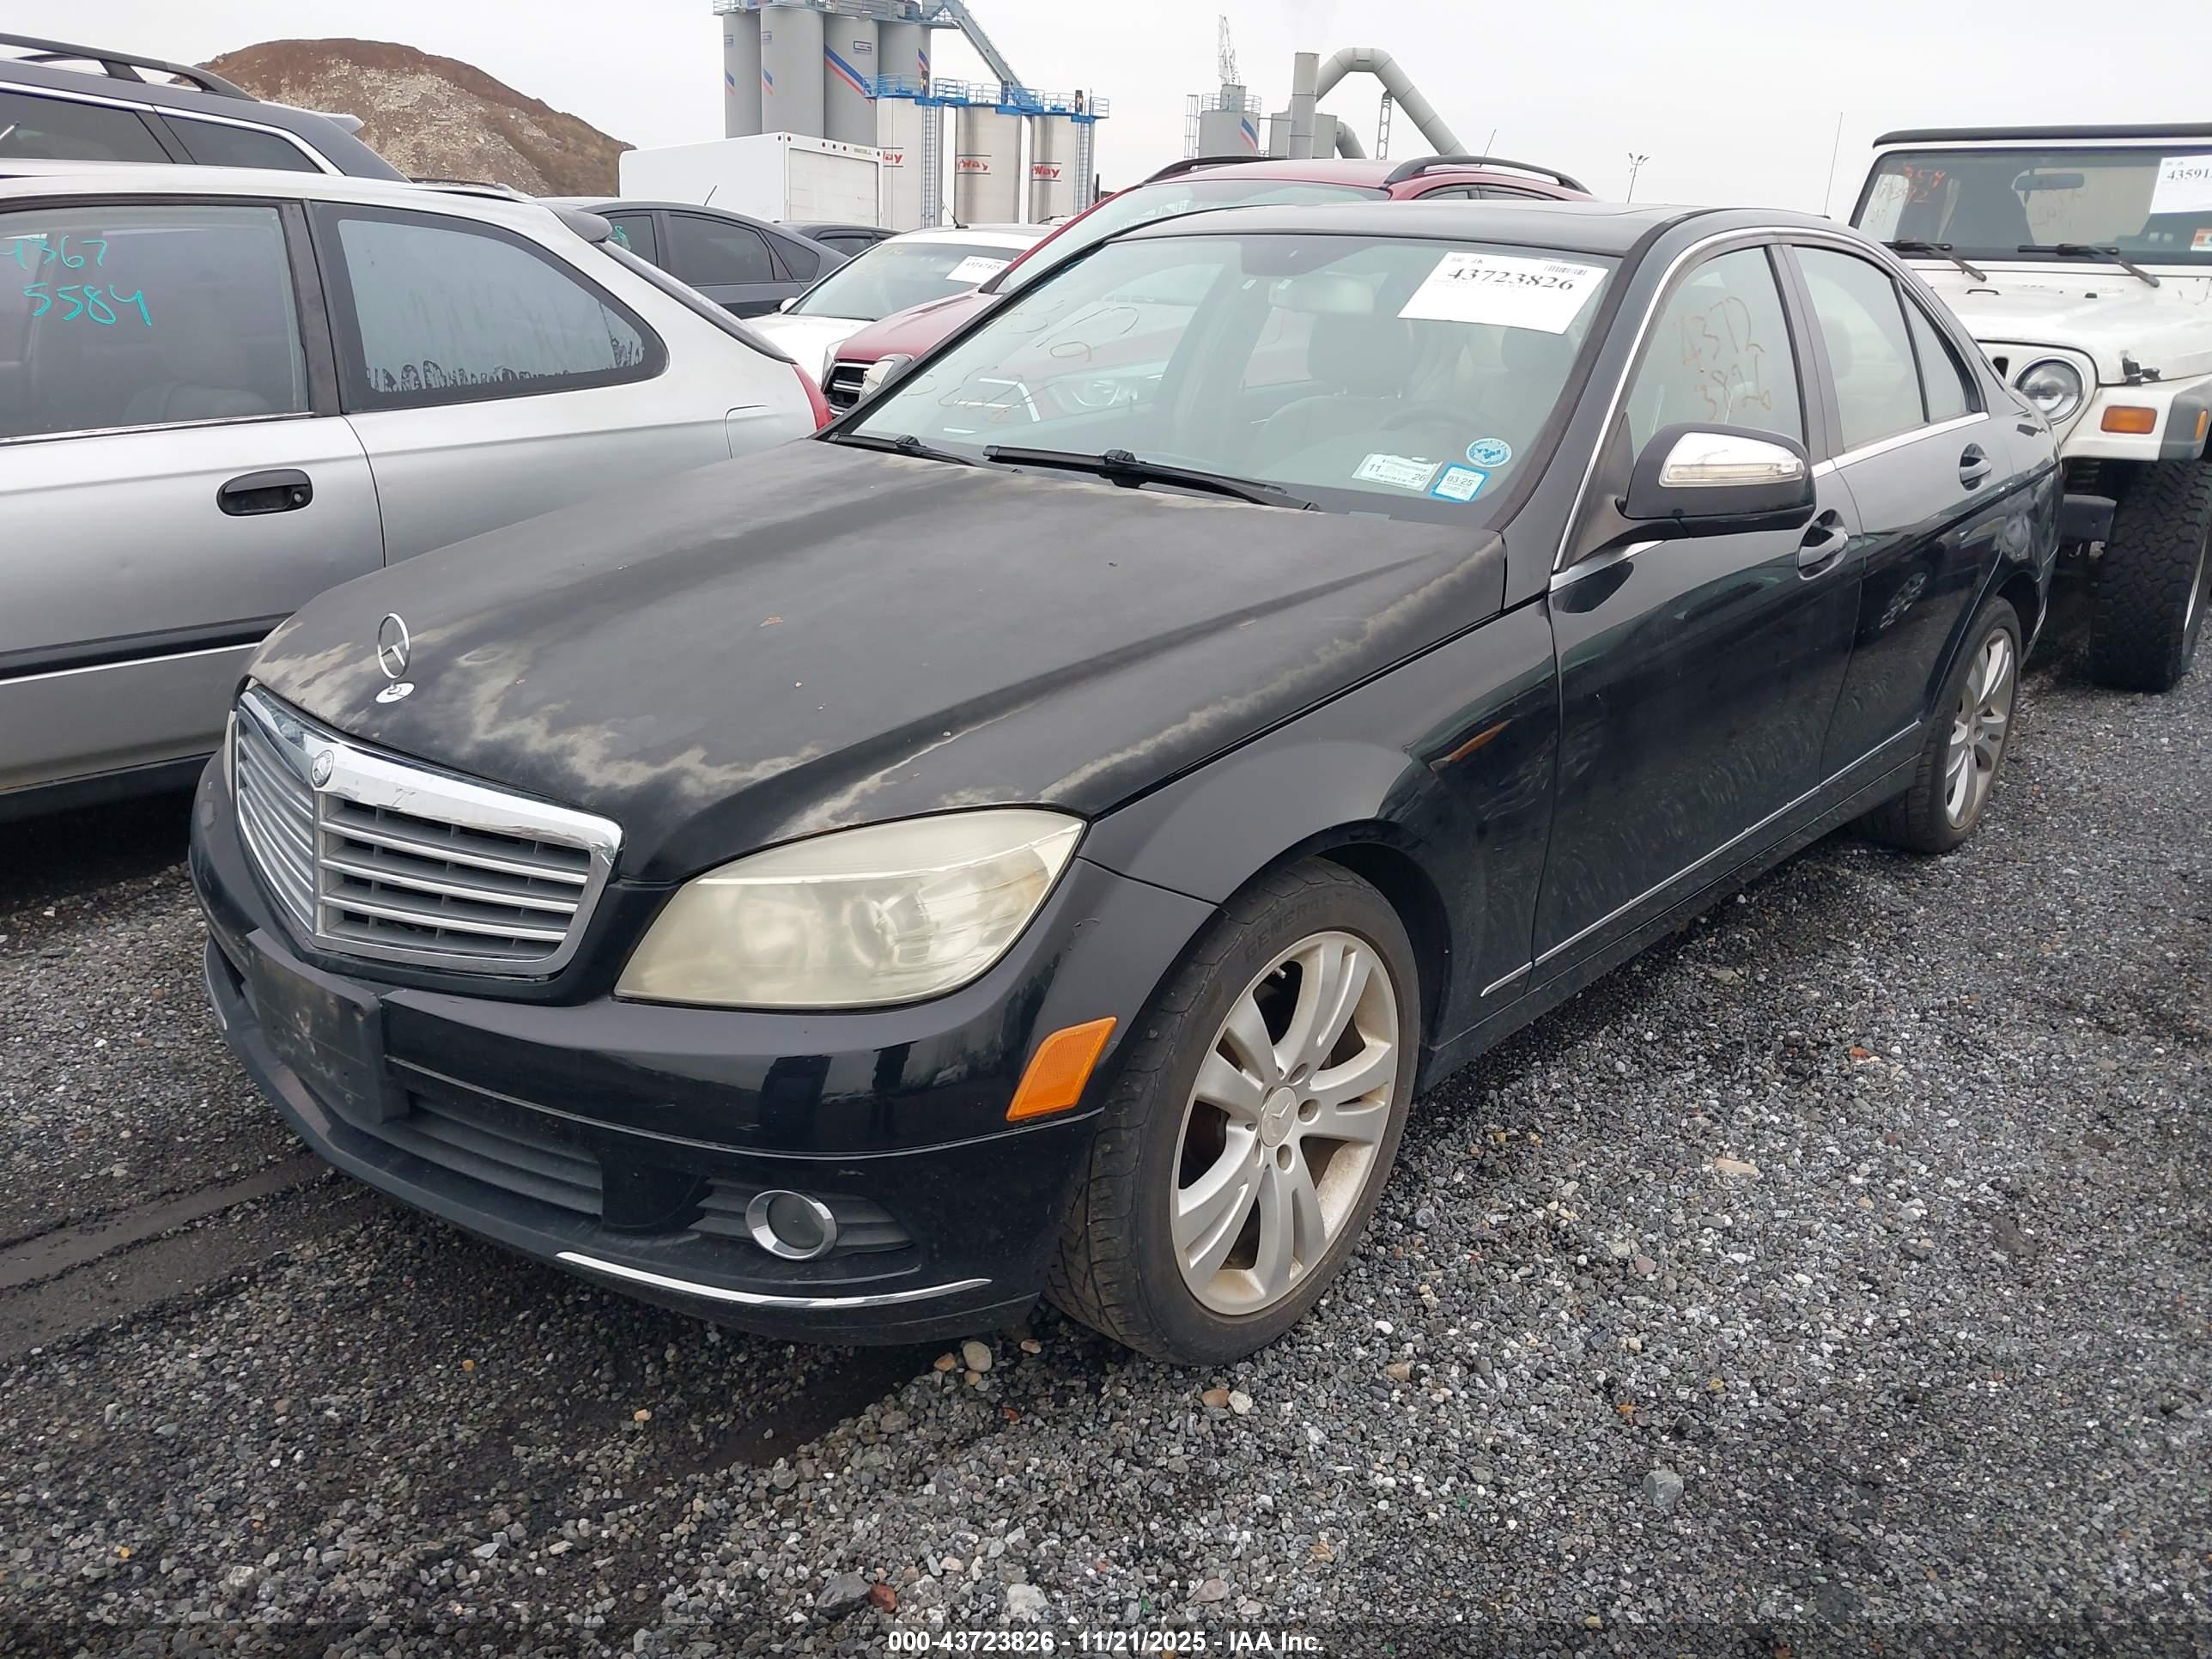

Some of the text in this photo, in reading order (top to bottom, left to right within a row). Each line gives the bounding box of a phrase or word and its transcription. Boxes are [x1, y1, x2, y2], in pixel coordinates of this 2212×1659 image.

[2166, 168, 2212, 180] 43591
[1448, 268, 1574, 290] 43723826
[23, 282, 152, 327] 5584
